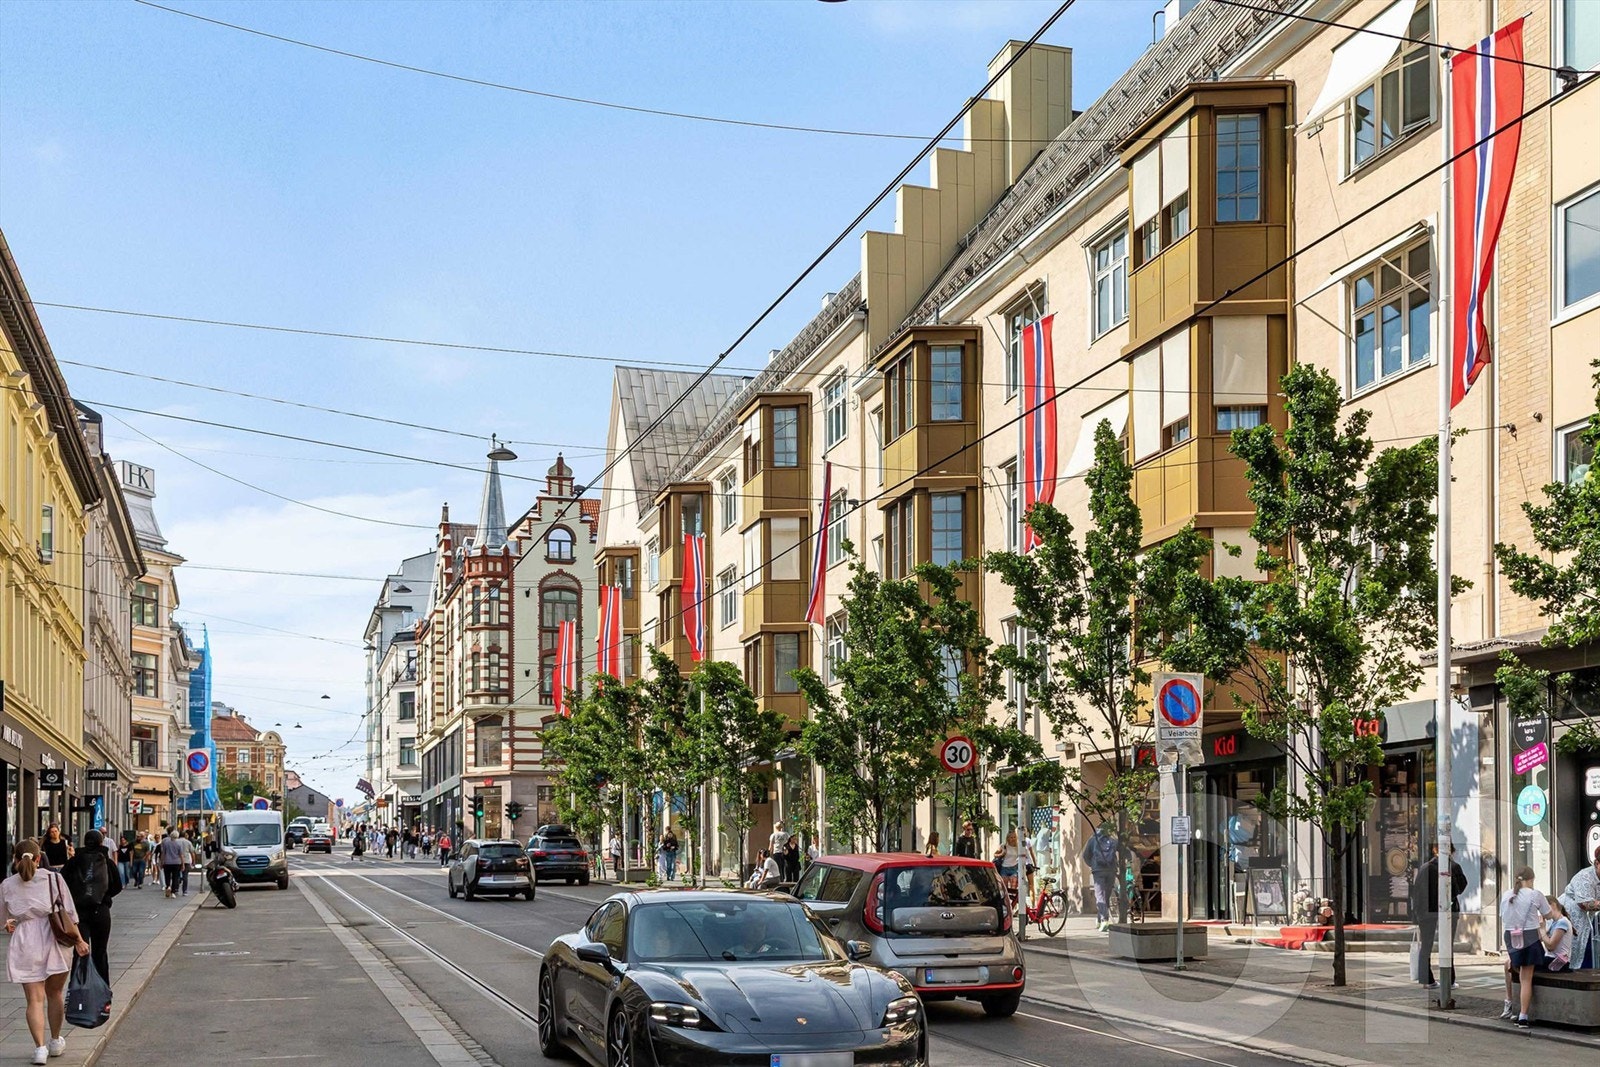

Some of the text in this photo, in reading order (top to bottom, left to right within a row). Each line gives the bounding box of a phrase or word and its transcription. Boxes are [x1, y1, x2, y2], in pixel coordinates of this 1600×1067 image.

[129, 464, 150, 489] HK
[1168, 729, 1198, 737] Veiarbeid
[947, 746, 970, 763] 30
[1214, 735, 1235, 756] Kid
